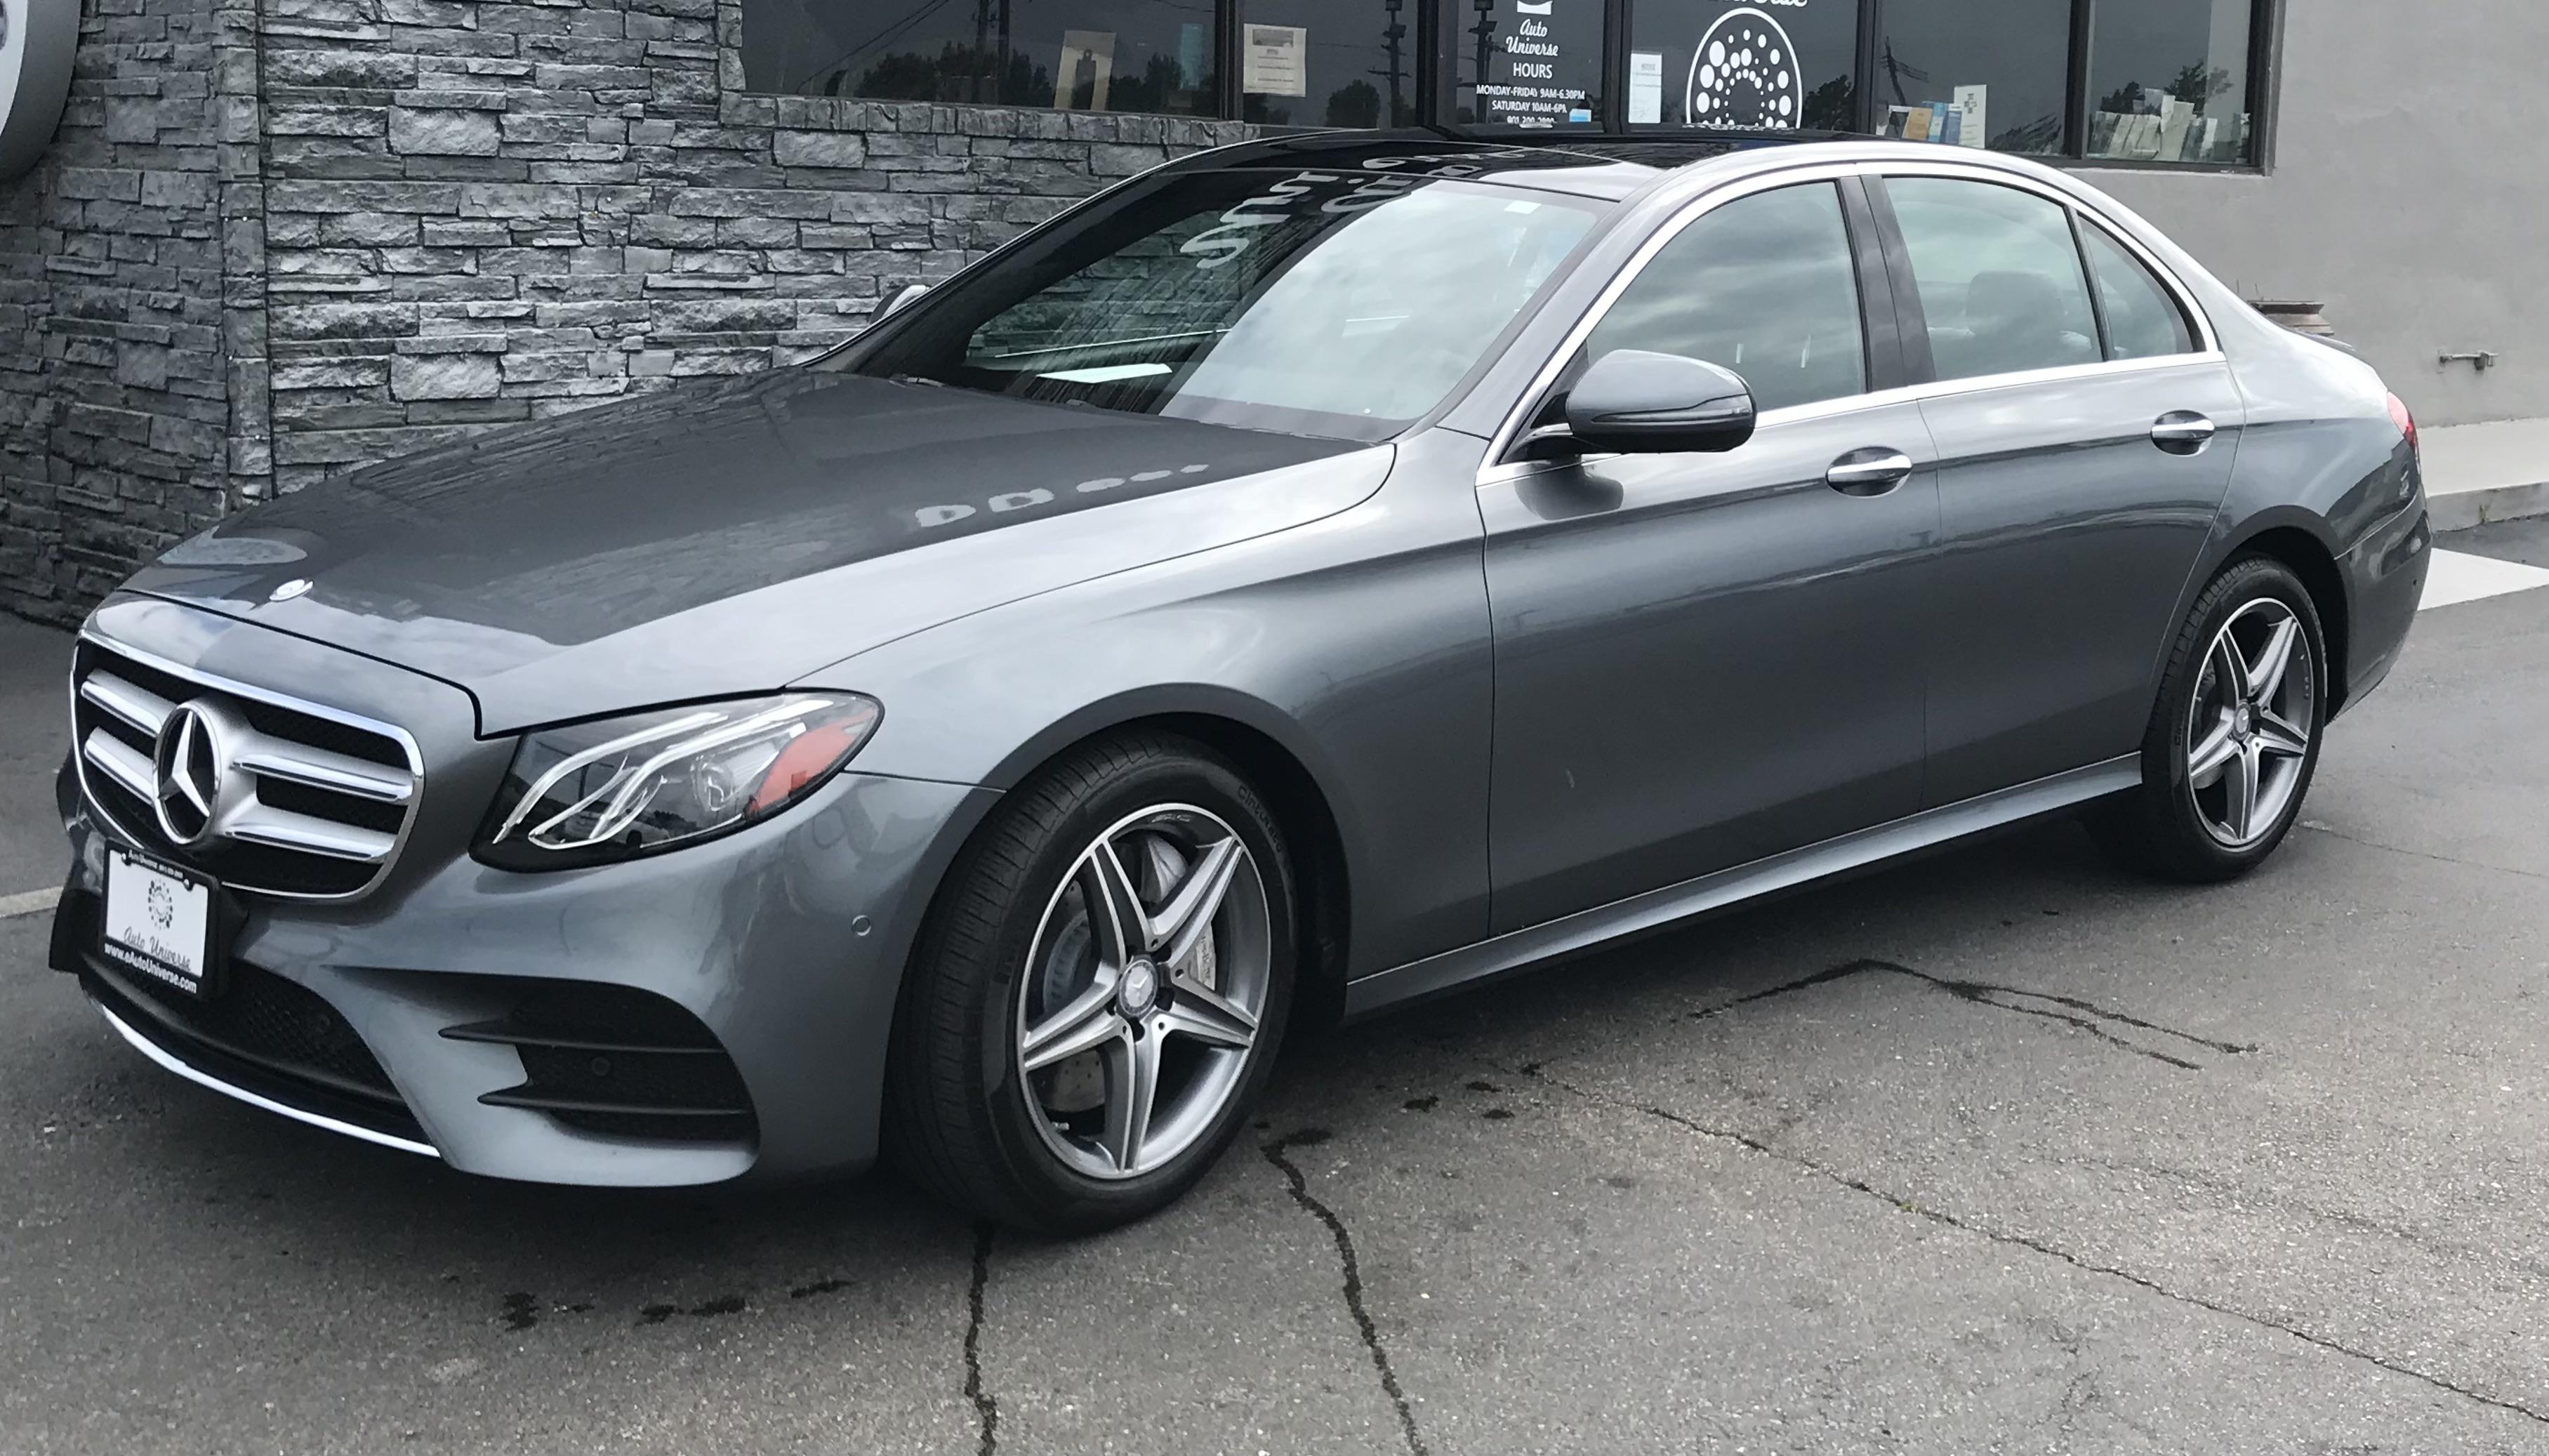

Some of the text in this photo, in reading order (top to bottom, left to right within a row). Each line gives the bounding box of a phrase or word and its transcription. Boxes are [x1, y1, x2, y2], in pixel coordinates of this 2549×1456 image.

[1520, 18, 1547, 37] Auto
[1506, 36, 1558, 56] Universe
[1513, 62, 1552, 79] HOURS
[1492, 100, 1530, 112] SATURDAY
[124, 926, 191, 972] Auto Universe
